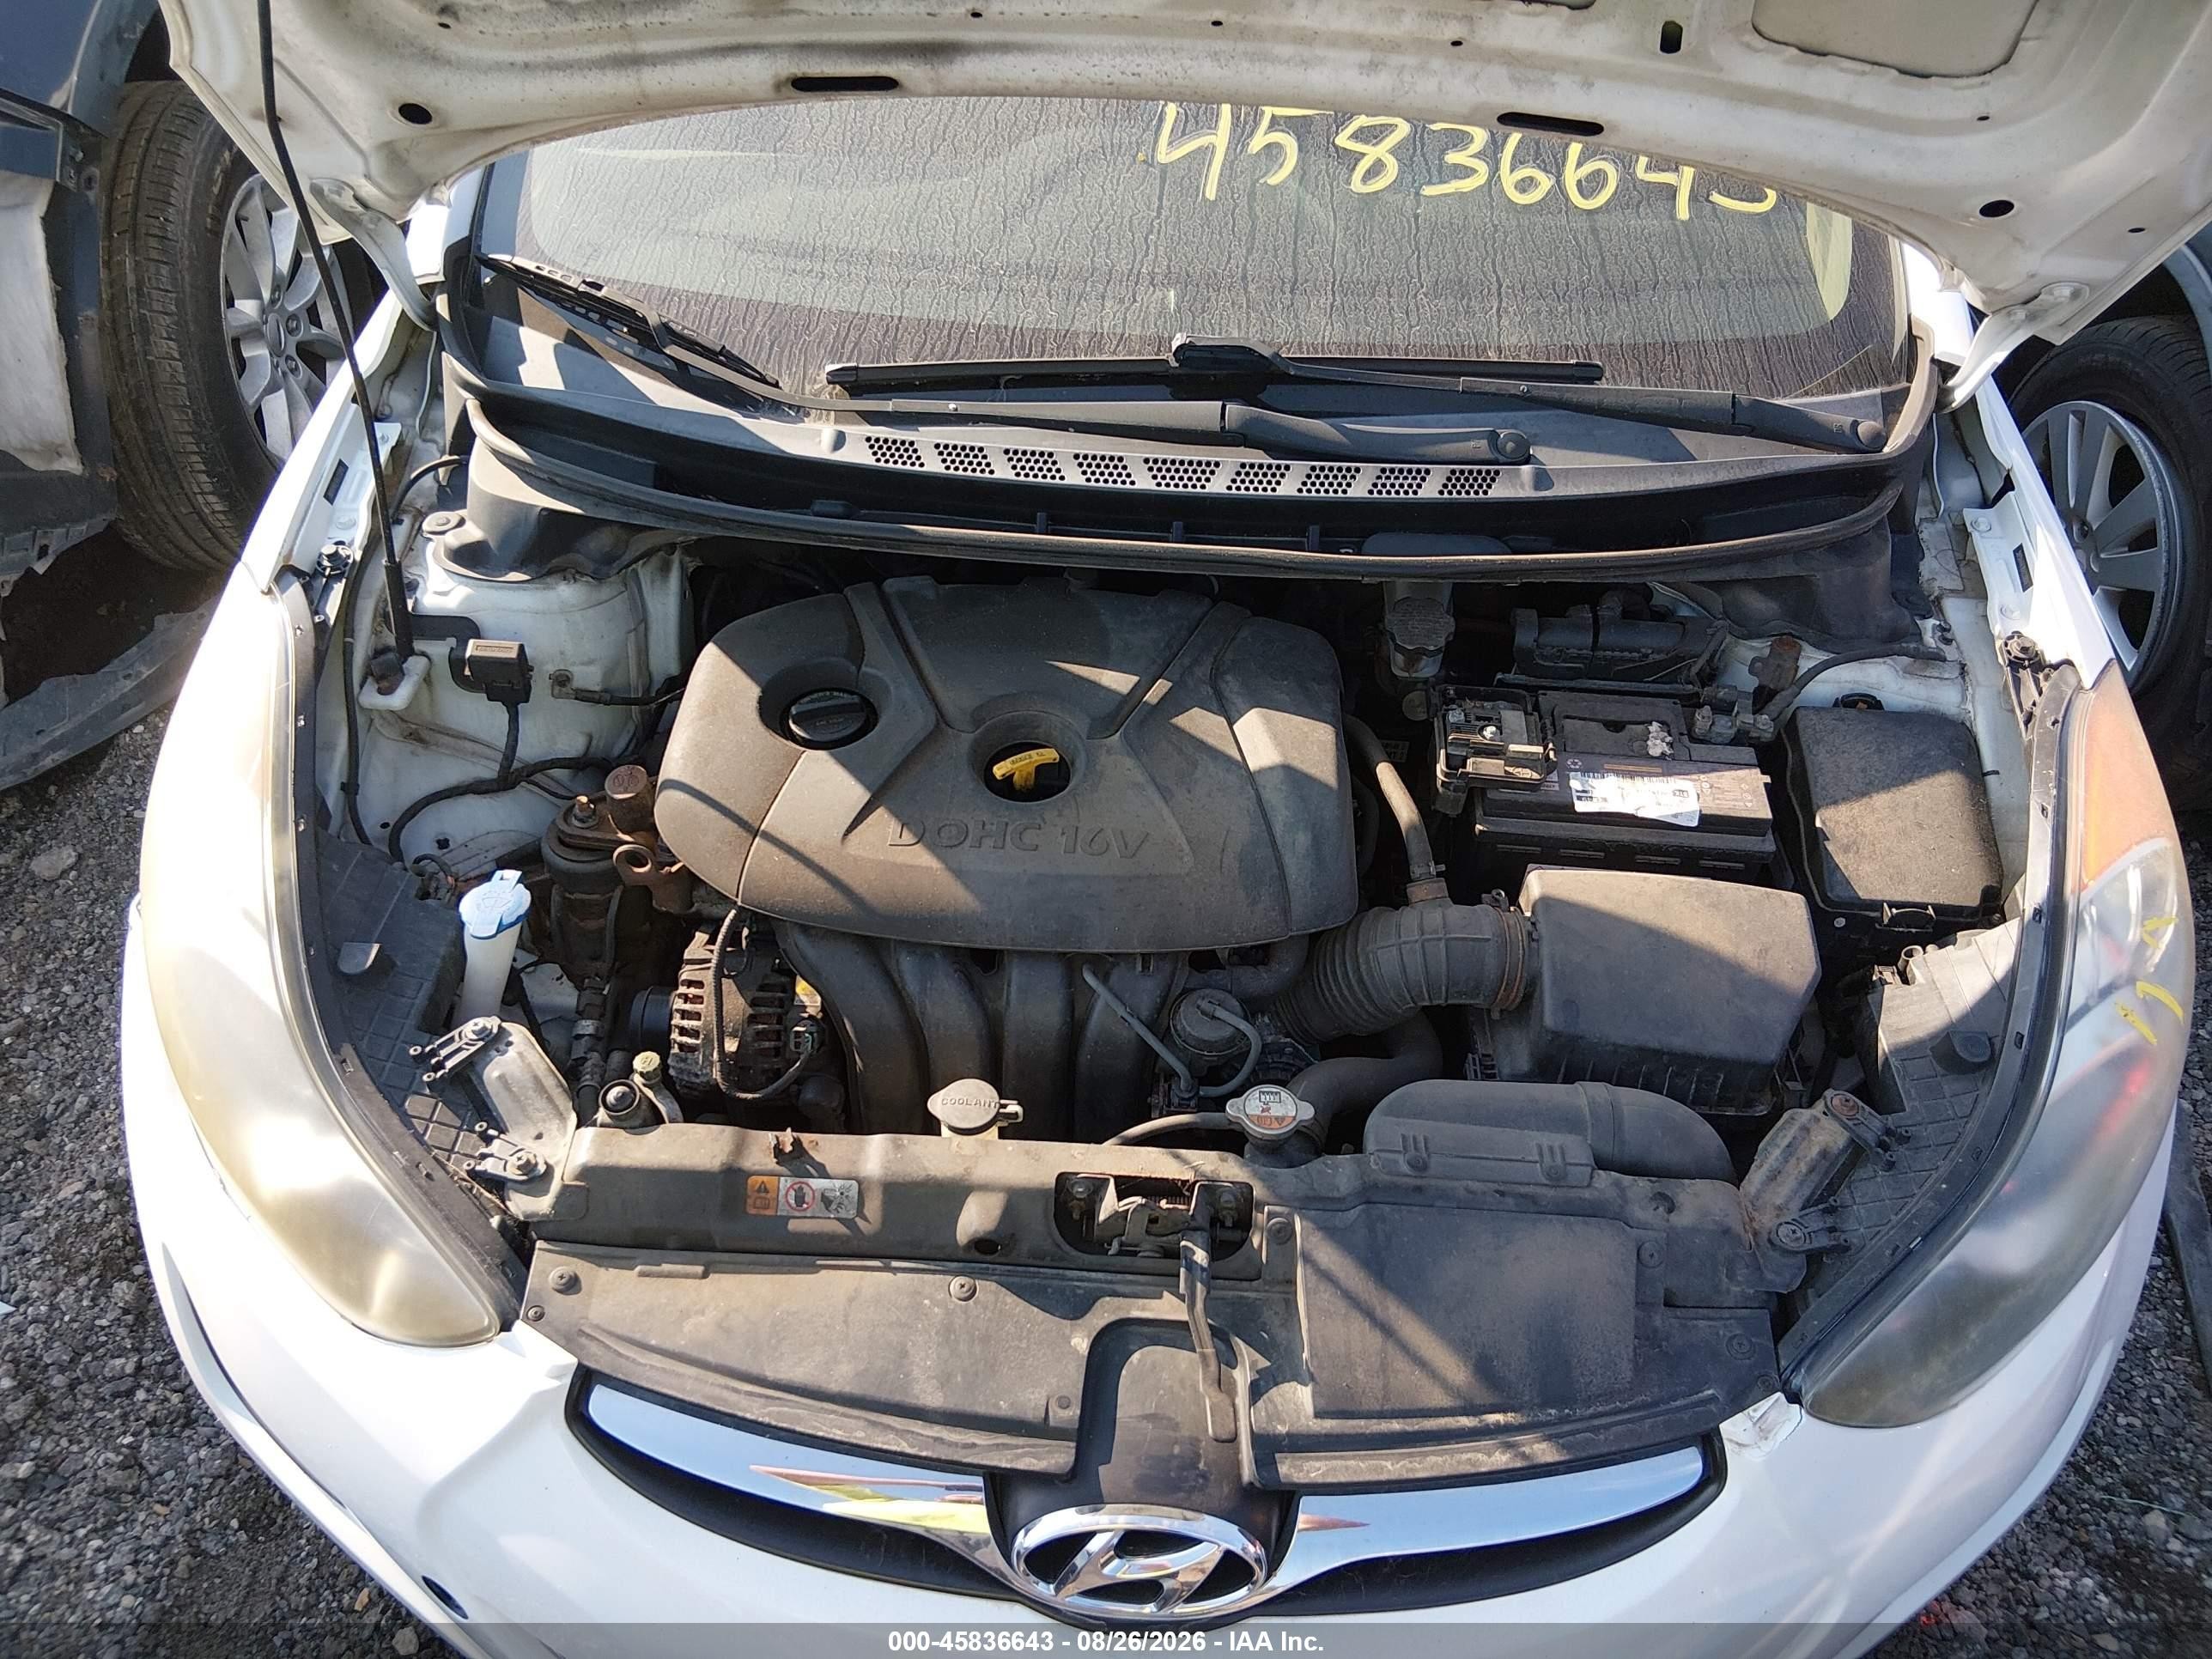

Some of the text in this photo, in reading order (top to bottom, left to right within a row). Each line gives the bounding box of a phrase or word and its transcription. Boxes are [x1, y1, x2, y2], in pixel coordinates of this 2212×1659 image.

[887, 818, 1150, 860] DOHC 16V
[941, 1097, 1000, 1109] COOLANT
